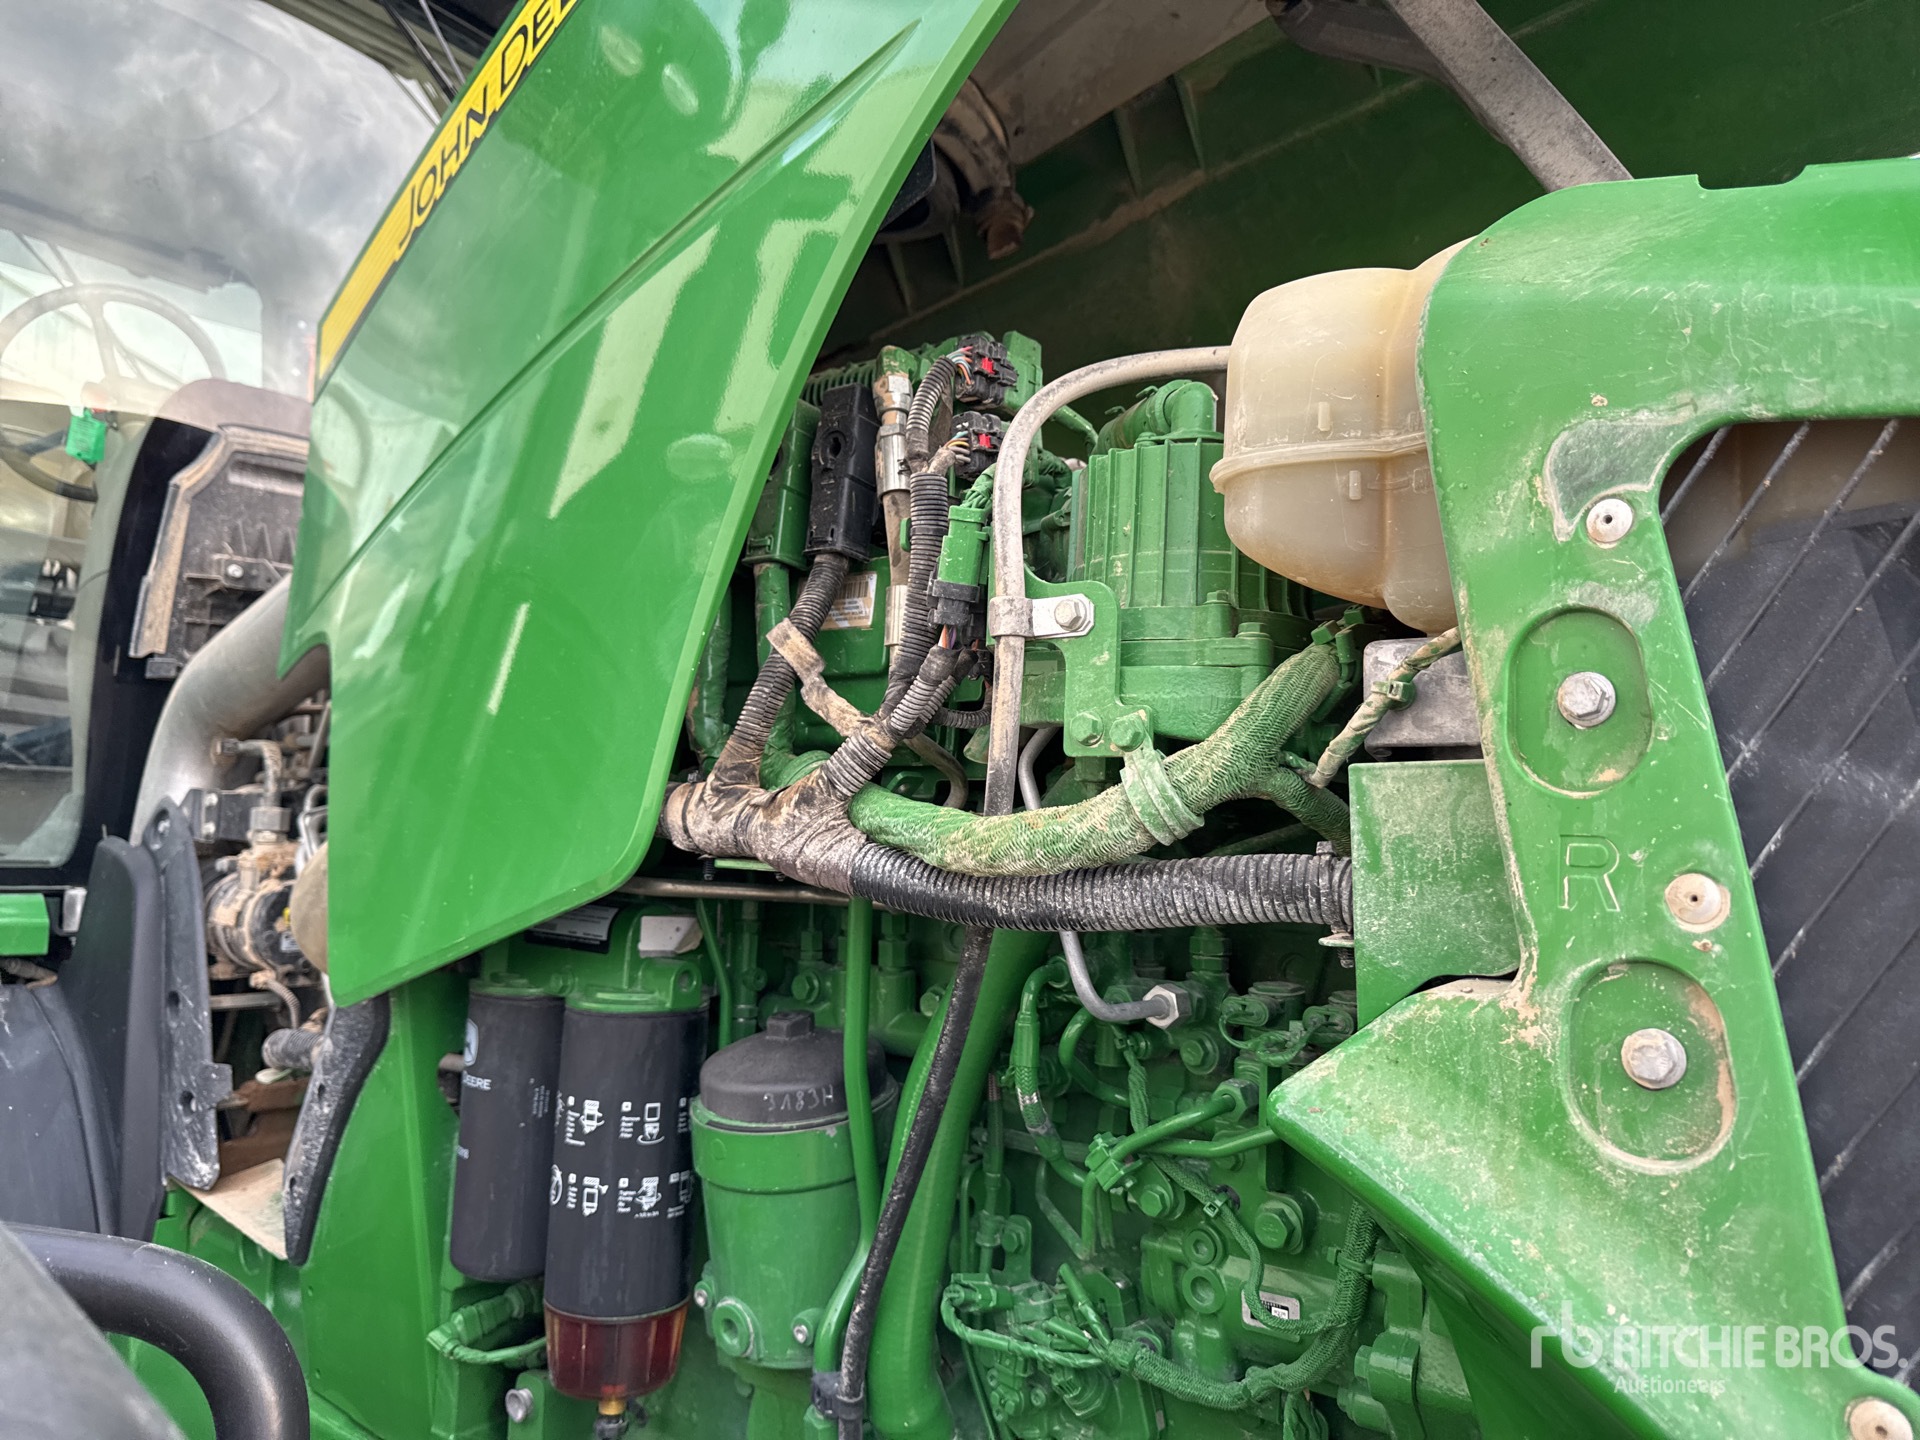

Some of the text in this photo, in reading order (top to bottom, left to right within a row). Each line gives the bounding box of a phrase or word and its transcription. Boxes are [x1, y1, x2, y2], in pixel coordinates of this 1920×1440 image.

[398, 0, 573, 251] JOHN DE
[1558, 834, 1620, 912] R
